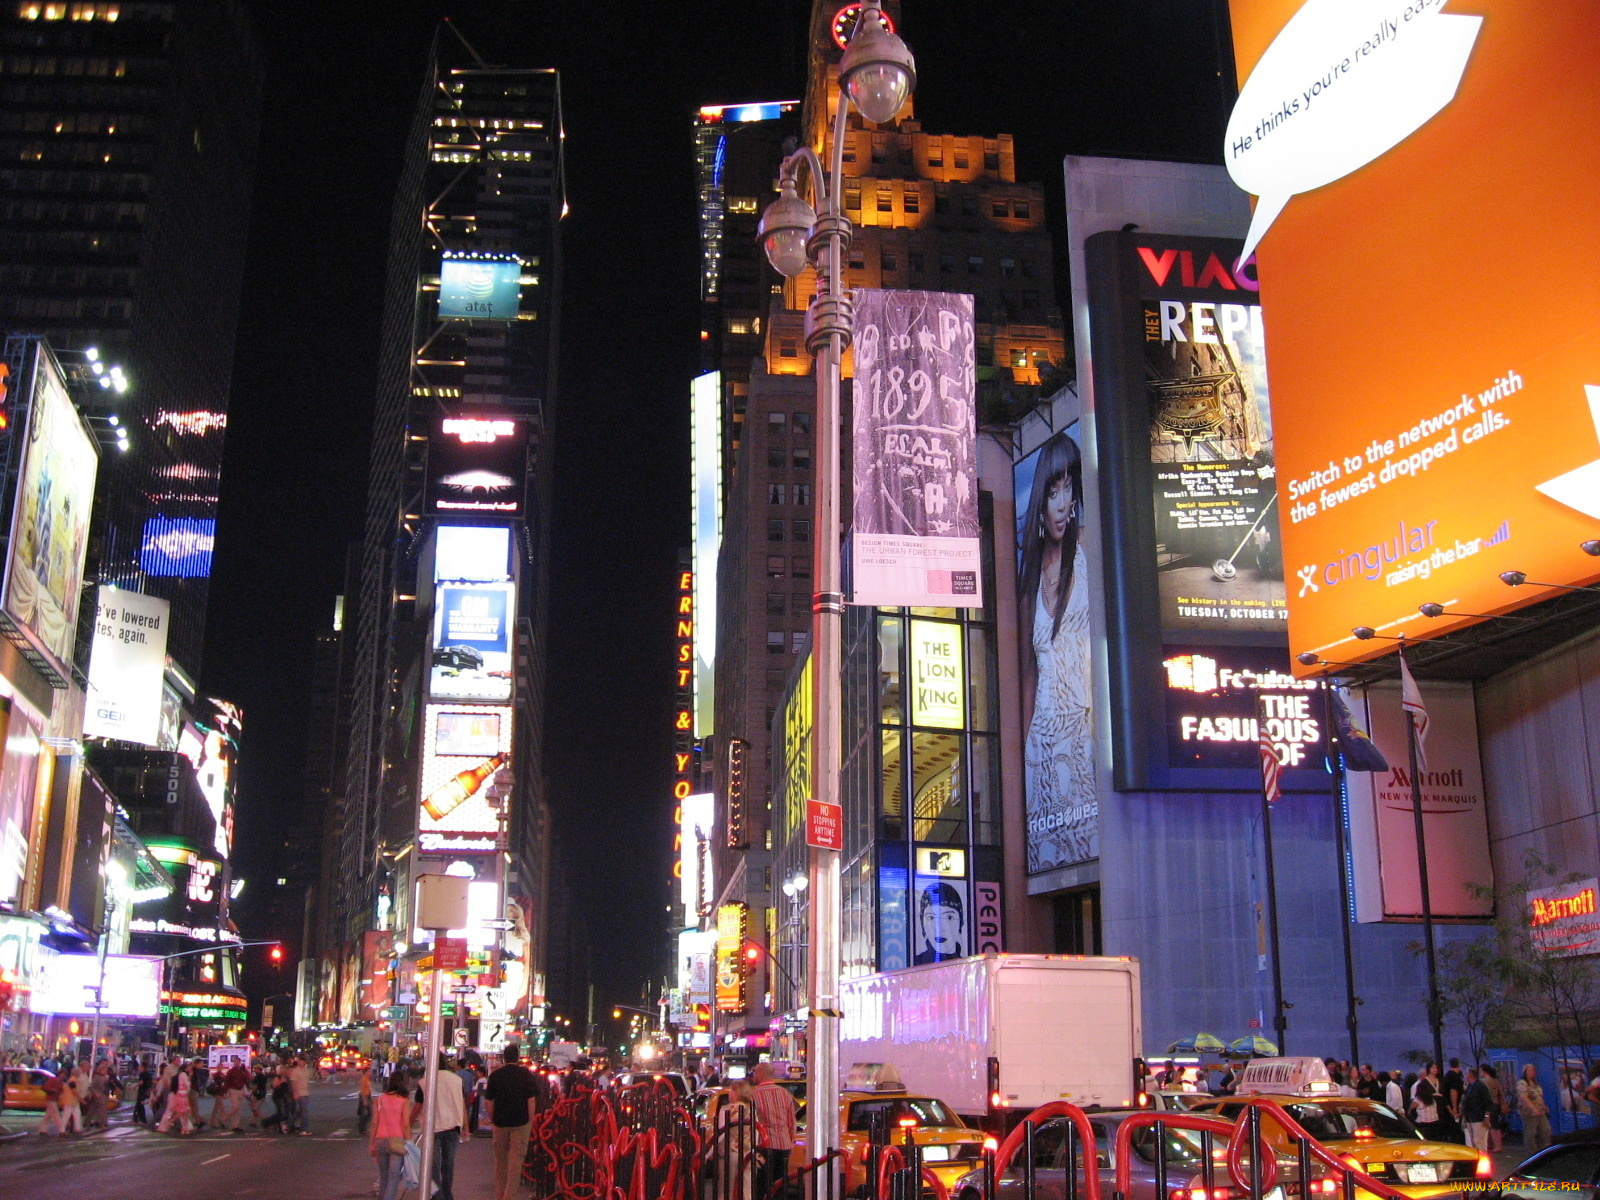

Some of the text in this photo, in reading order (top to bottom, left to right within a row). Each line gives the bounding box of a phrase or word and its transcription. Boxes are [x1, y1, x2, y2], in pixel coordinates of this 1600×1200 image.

[1233, 0, 1441, 159] He thinks you're really ea
[464, 300, 493, 313] at&t
[1145, 309, 1159, 342] THEY
[1288, 370, 1523, 500] Switch to the network with
[1290, 410, 1511, 523] the fewest dropped calls.
[878, 547, 906, 555] URBAN
[908, 548, 937, 557] FOREST
[940, 549, 973, 558] PROJECT
[1323, 519, 1437, 586] cingular
[1385, 537, 1482, 587] raising the bar
[1177, 596, 1189, 604] See
[1191, 597, 1217, 606] history
[1244, 599, 1267, 607] making.
[1271, 599, 1287, 607] LIVE
[121, 607, 160, 630] lowered
[1177, 606, 1228, 619] TUESDAY,
[1230, 608, 1275, 619] OCTOBER
[118, 628, 148, 644] again.
[677, 571, 692, 687] ERNST
[923, 641, 950, 657] THE
[918, 660, 956, 684] LION
[918, 687, 957, 711] KING
[1260, 695, 1310, 719] THE
[676, 711, 691, 730] &
[1273, 742, 1306, 766] OF
[166, 753, 180, 804] 1500
[1388, 767, 1464, 787] Mrriott
[1380, 791, 1477, 804] NEW YK MARQUIS
[819, 804, 829, 816] NO
[813, 815, 837, 828] STOPPING
[814, 825, 835, 838] ANYTIME
[929, 851, 952, 871] MTV
[1531, 888, 1595, 927] Marriott
[174, 1006, 201, 1018] FECT
[200, 1008, 224, 1018] GAME
